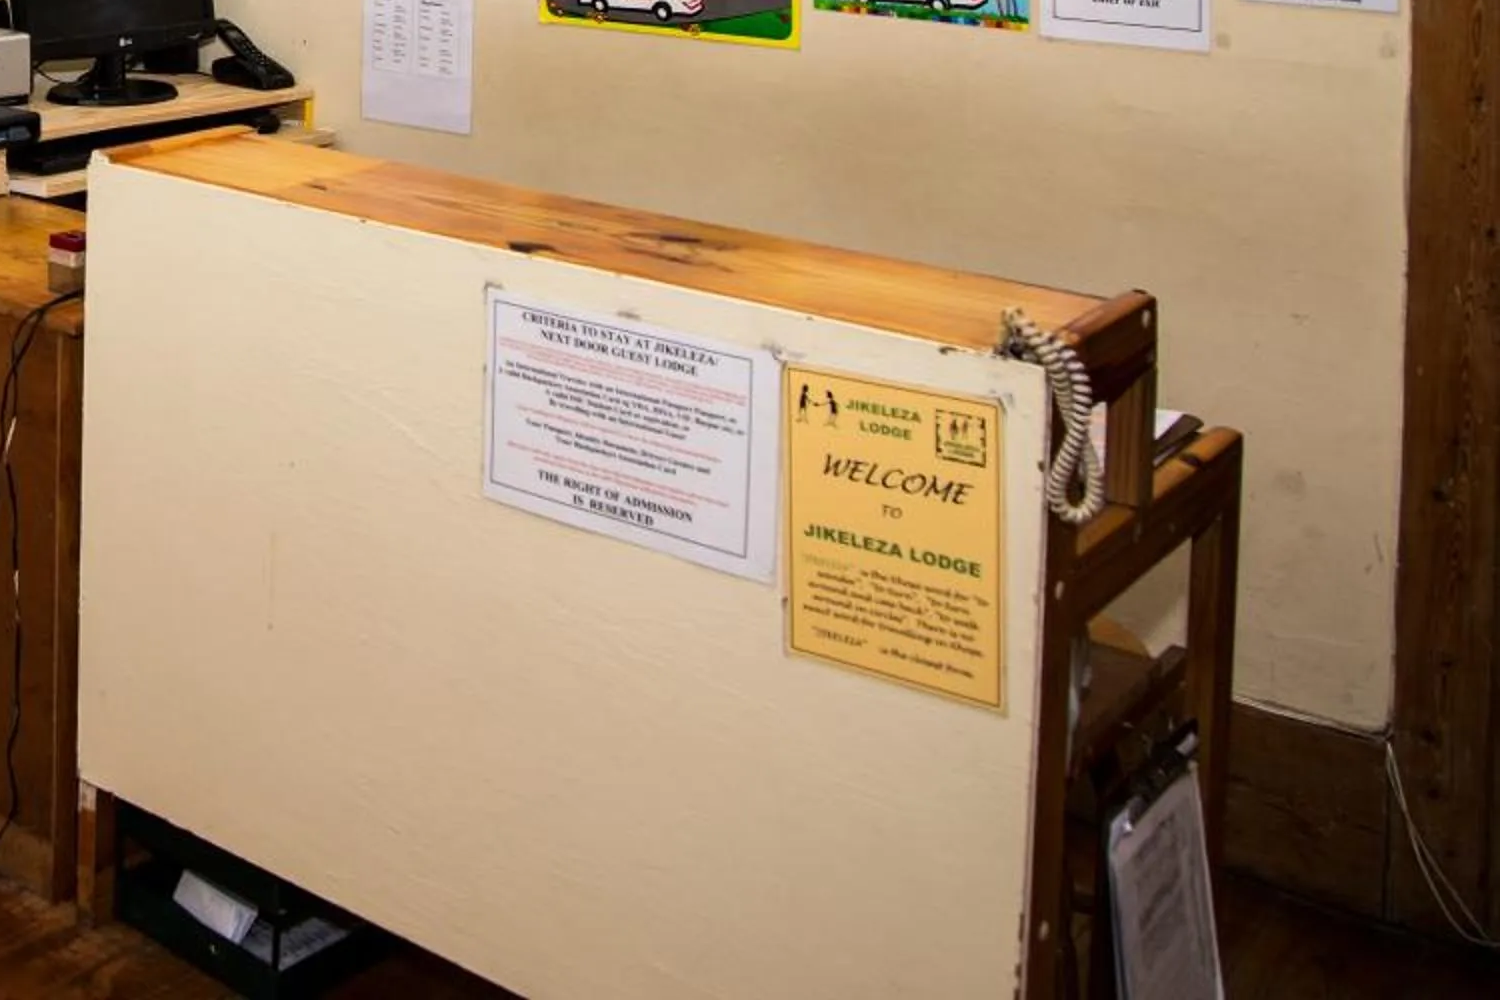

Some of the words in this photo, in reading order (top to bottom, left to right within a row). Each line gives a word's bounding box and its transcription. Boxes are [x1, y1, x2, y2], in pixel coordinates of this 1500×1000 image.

[522, 311, 578, 333] CRITERIA
[581, 324, 598, 338] TO
[601, 329, 630, 346] STAY
[635, 337, 651, 350] AT
[541, 328, 570, 346] NEXT
[573, 338, 609, 356] DOOR
[611, 347, 651, 366] GUEST
[654, 355, 699, 377] LODGE
[845, 399, 923, 424] JIKELEZA
[859, 420, 913, 441] LODGE
[538, 469, 561, 485] THE
[563, 477, 602, 496] RIGHT
[604, 487, 620, 501] OF
[624, 495, 694, 523] ADMISSION
[823, 453, 975, 506] WELCOME
[572, 494, 585, 506] IS
[589, 499, 655, 526] RESERVED
[881, 504, 903, 519] TO
[803, 523, 904, 560] JIKELEZA
[910, 547, 983, 579] LODGE
